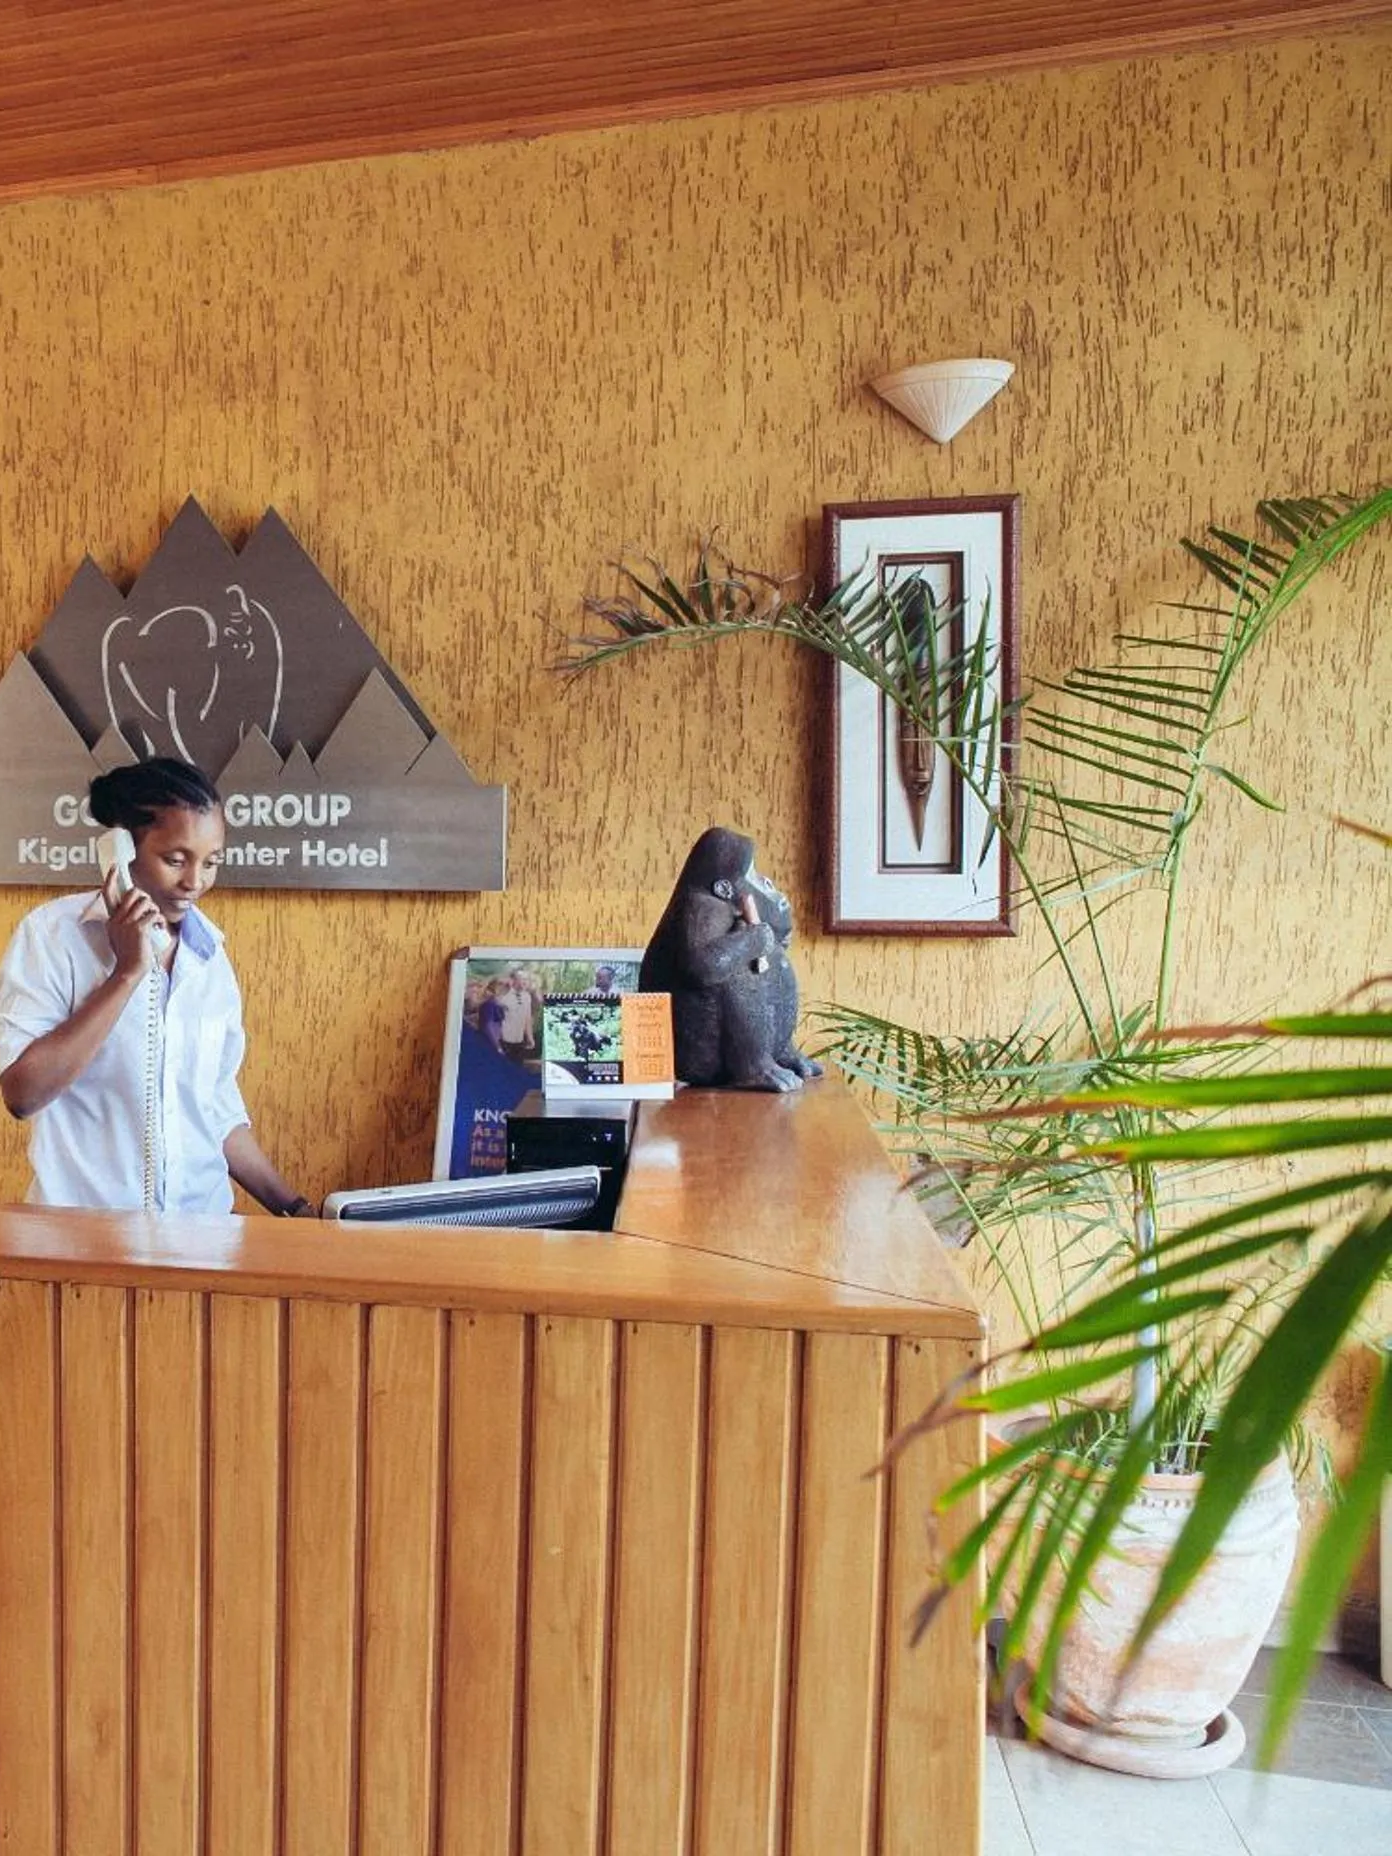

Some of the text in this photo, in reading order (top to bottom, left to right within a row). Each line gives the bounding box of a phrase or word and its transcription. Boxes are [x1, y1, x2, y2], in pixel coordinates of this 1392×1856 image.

[224, 793, 352, 828] GROUP
[18, 837, 97, 871] Kigal
[301, 838, 389, 867] Hotel
[474, 1109, 513, 1124] KNO
